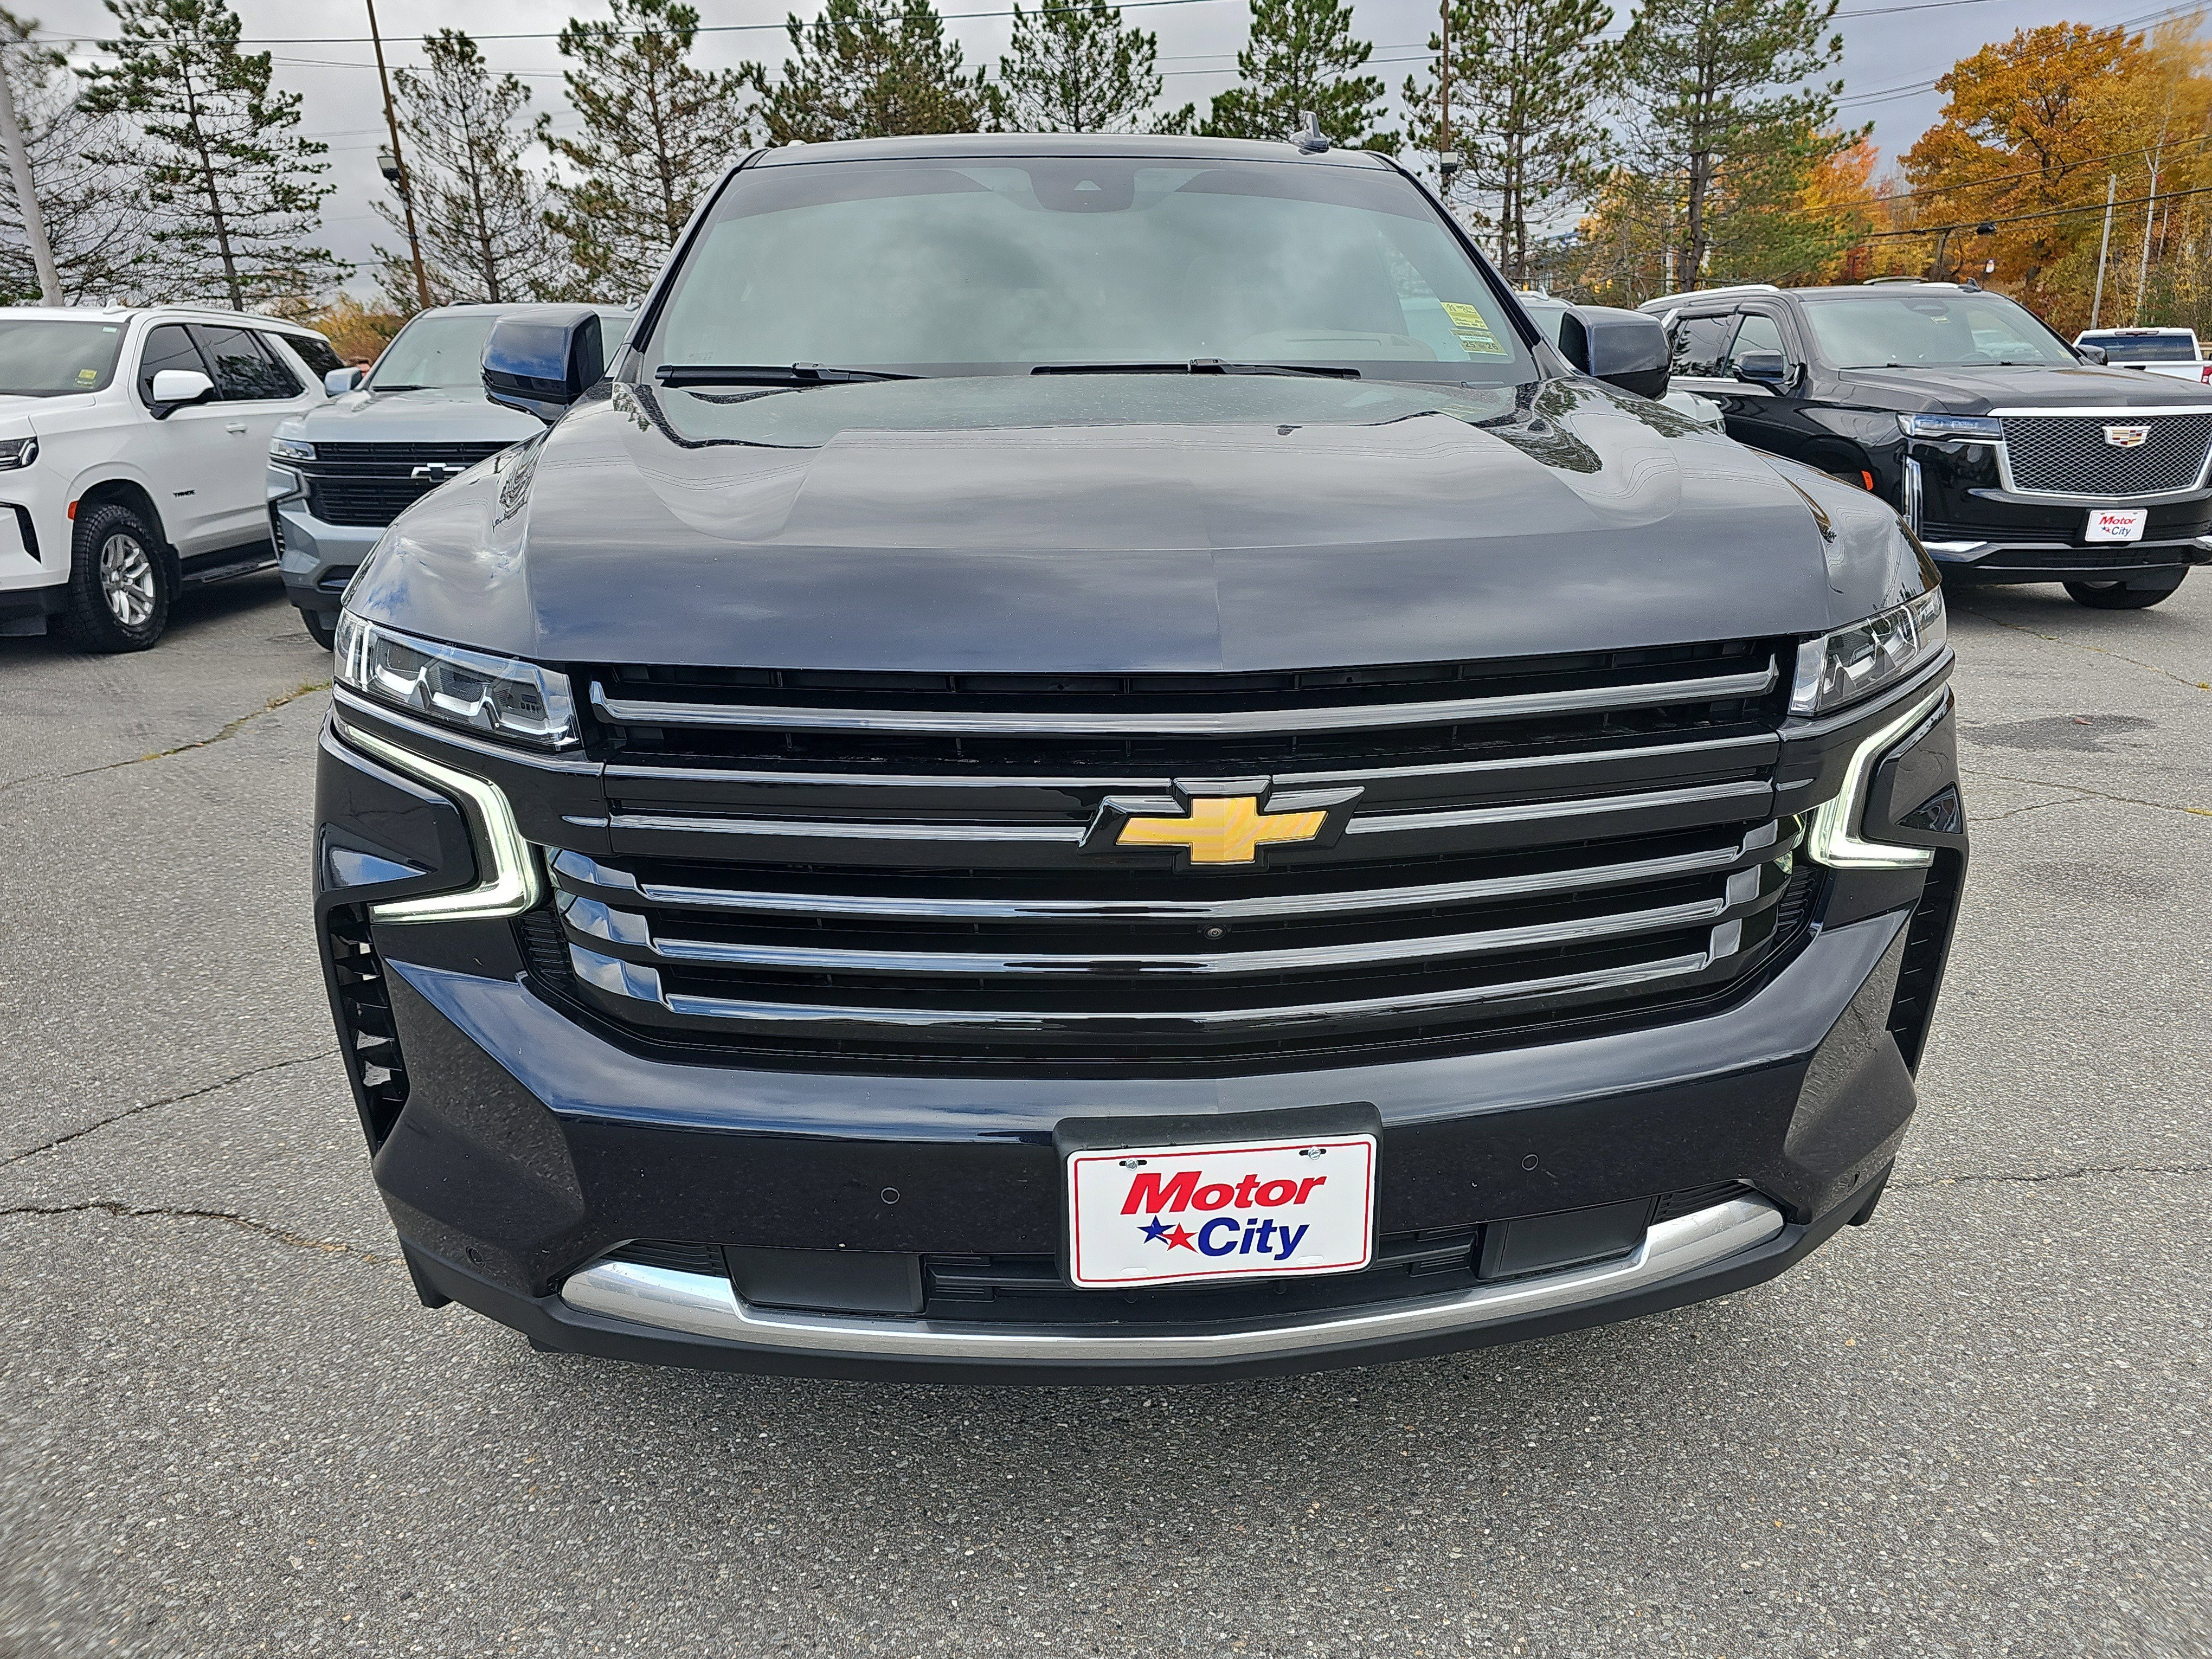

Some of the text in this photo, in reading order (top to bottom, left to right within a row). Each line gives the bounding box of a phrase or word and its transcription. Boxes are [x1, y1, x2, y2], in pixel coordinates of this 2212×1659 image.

[2099, 516, 2136, 525] Motor
[2111, 526, 2131, 537] City
[1120, 1171, 1327, 1215] Motor
[1198, 1217, 1310, 1261] City
